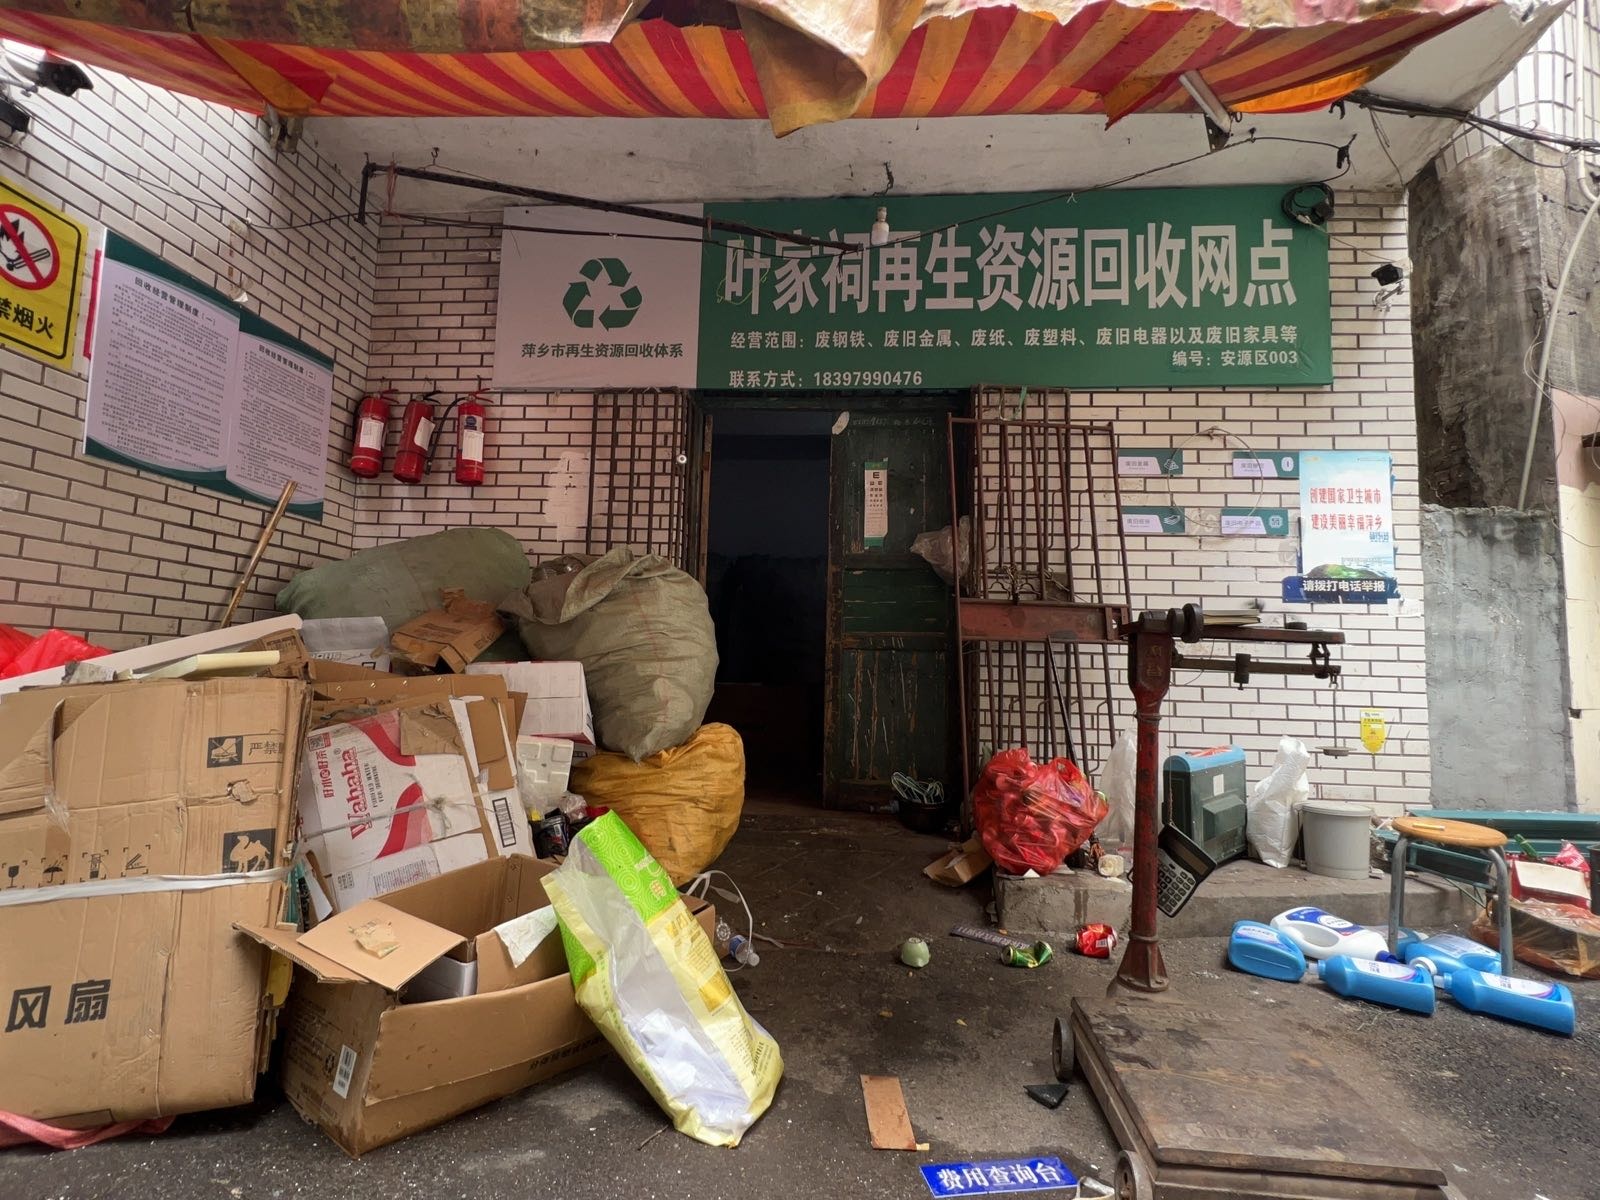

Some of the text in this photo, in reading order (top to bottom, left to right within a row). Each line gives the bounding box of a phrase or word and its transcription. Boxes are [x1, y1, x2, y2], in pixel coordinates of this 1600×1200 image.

[725, 218, 1298, 316] 叶家祠再生资源回收网点
[521, 342, 684, 359] 萍乡市再生资源回收体系
[1309, 487, 1382, 505] 创建国家卫生城市
[1311, 513, 1383, 531] 建设美丽幸福萍乡
[1302, 579, 1386, 592] 请拨打电话举报
[5, 978, 112, 1033] 风扇
[936, 1163, 1062, 1191] 费用查询台
